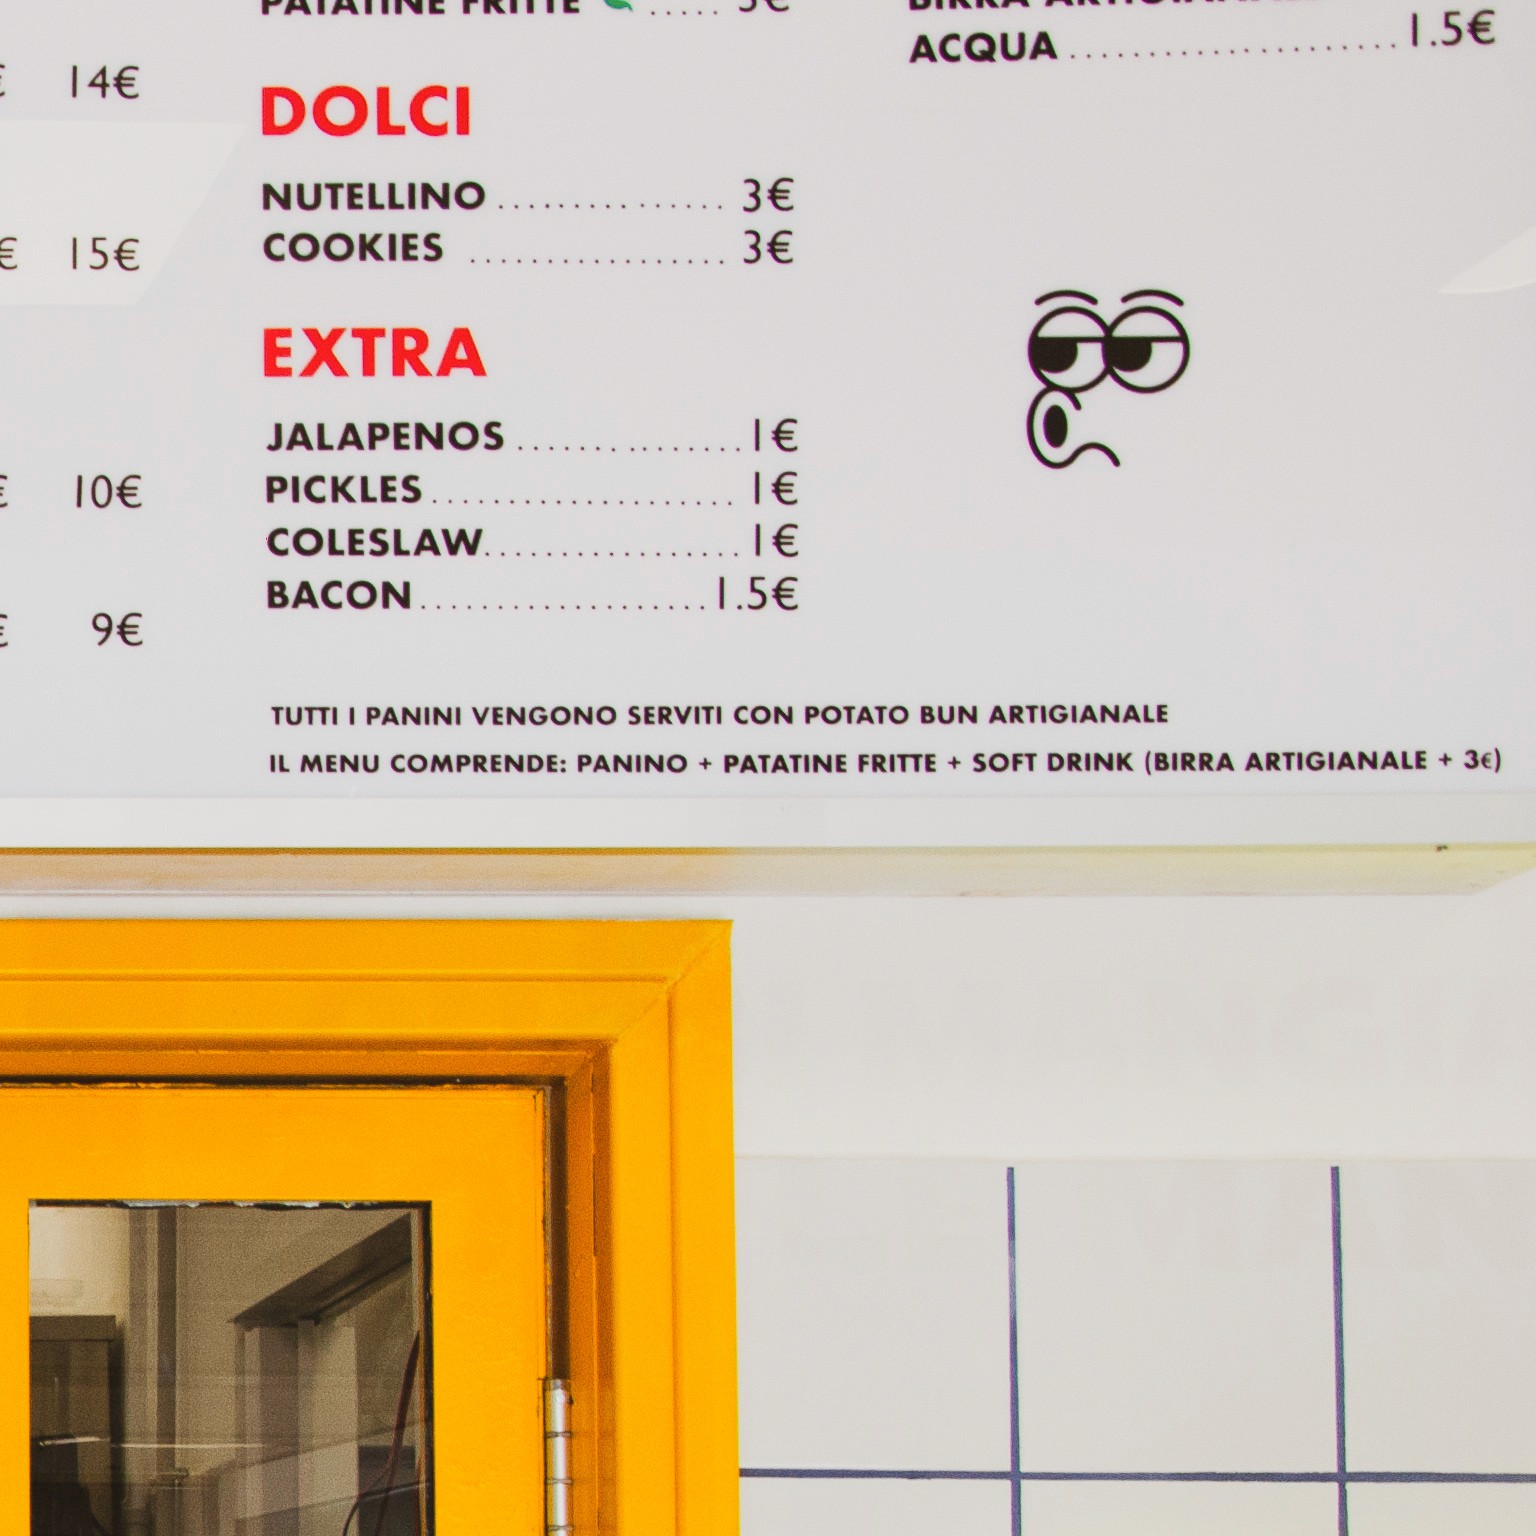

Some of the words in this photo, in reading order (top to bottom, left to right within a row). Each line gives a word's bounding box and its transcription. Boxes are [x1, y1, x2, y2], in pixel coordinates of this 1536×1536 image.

[908, 31, 1058, 64] ACQUA
[1411, 9, 1495, 48] 1.5€
[71, 65, 140, 100] 14€
[261, 84, 471, 138] DOLCI
[262, 181, 486, 212] NUTELLINO
[742, 176, 794, 214] 3€
[71, 236, 140, 272] 15€
[262, 232, 444, 263] COOKIES
[743, 229, 794, 265] 3€
[263, 327, 487, 378] EXTRA
[266, 420, 504, 452] JALAPENOS
[75, 474, 142, 510] 10€
[265, 474, 422, 505] PICKLES
[266, 527, 483, 558] COLESLAW
[266, 579, 411, 611] BACON
[718, 575, 799, 612] 1.5€
[91, 612, 143, 647] 9€
[271, 706, 338, 727] TUTTI
[365, 706, 462, 726] PANINI
[471, 705, 617, 727] VENGONO
[627, 705, 723, 726] SERVITI
[732, 705, 794, 726] CON
[804, 705, 910, 726] POTATO
[919, 705, 978, 726] BUN
[988, 703, 1168, 725] ARTIGIANALE
[269, 754, 290, 773] IL
[299, 754, 380, 774] MENU
[389, 753, 567, 774] COMPRENDE:
[576, 753, 688, 774] PANINO
[723, 753, 847, 774] PATATINE
[857, 753, 937, 774] FRITTE
[972, 752, 1038, 774] SOFT
[1046, 752, 1134, 773] DRINK
[1144, 750, 1235, 776] (BIRRA
[1244, 750, 1427, 772] ARTIGIANALE
